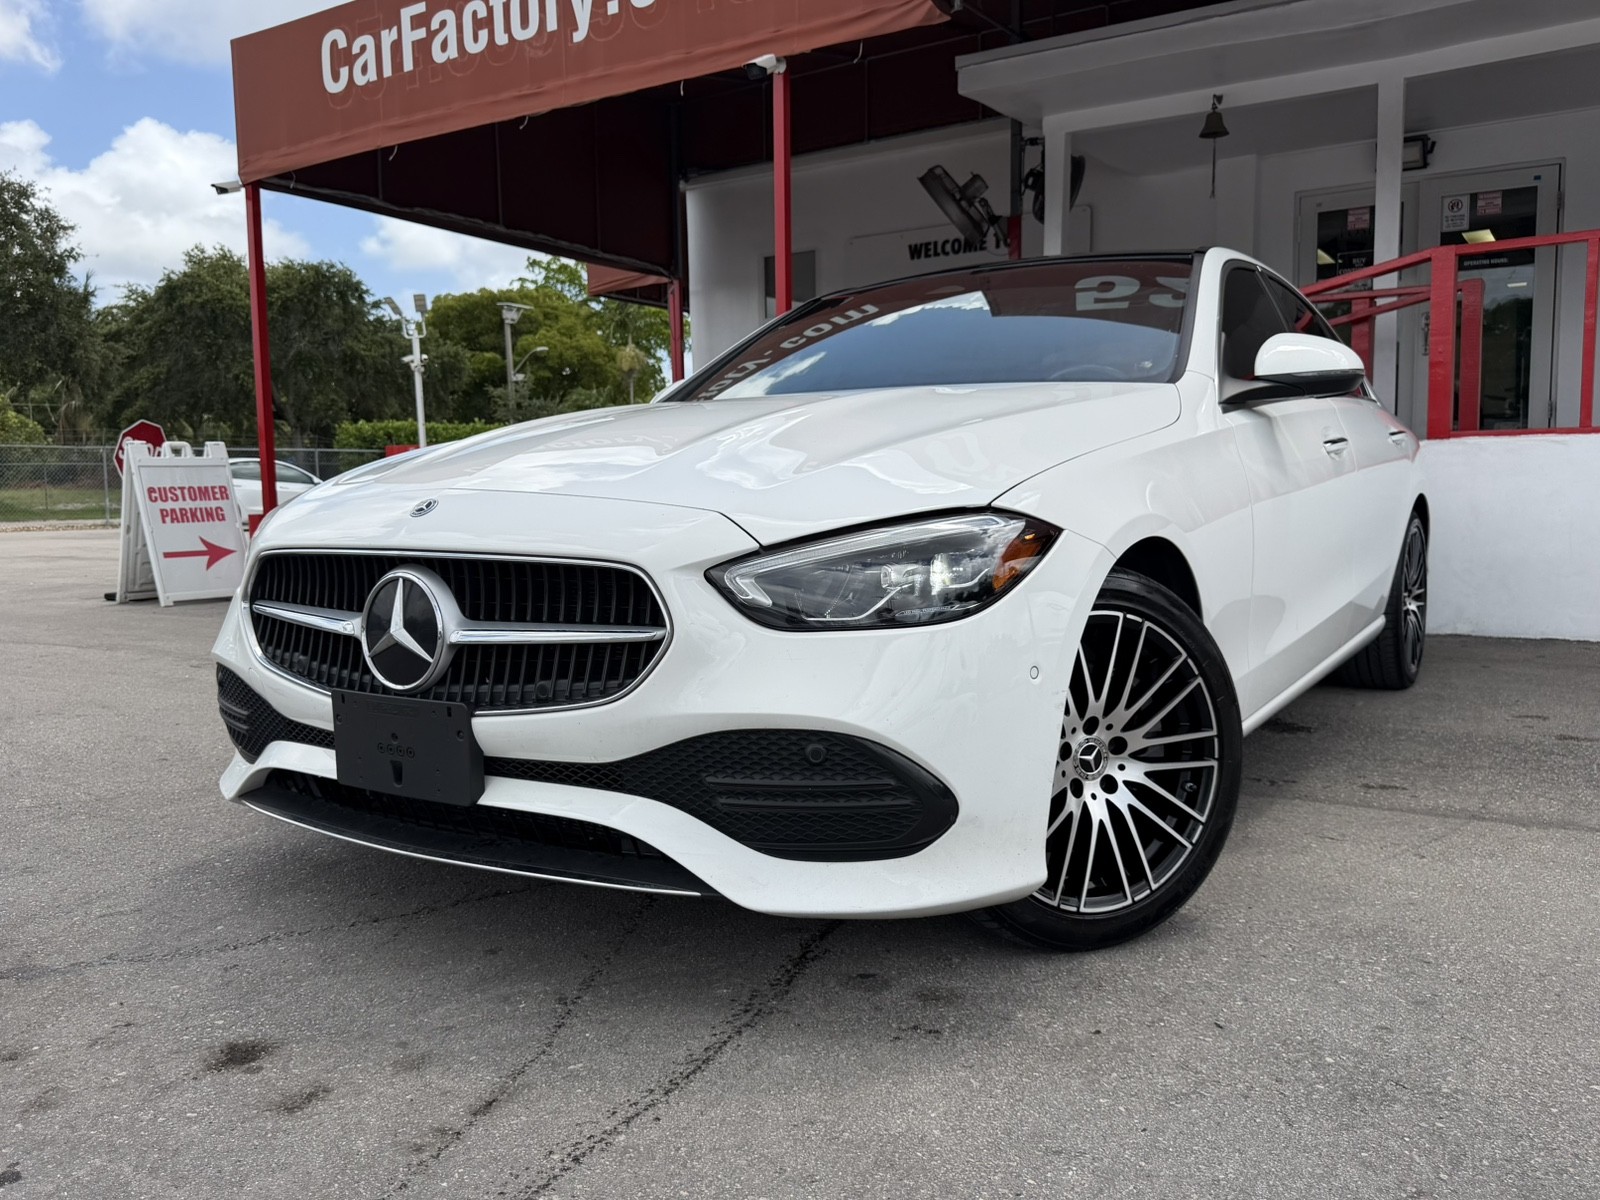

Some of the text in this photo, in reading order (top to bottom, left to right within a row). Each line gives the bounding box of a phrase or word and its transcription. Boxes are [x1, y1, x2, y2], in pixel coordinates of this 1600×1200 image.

[321, 0, 656, 94] CarFactory.
[147, 485, 230, 503] CUSTOMER
[159, 506, 227, 524] PARKING
